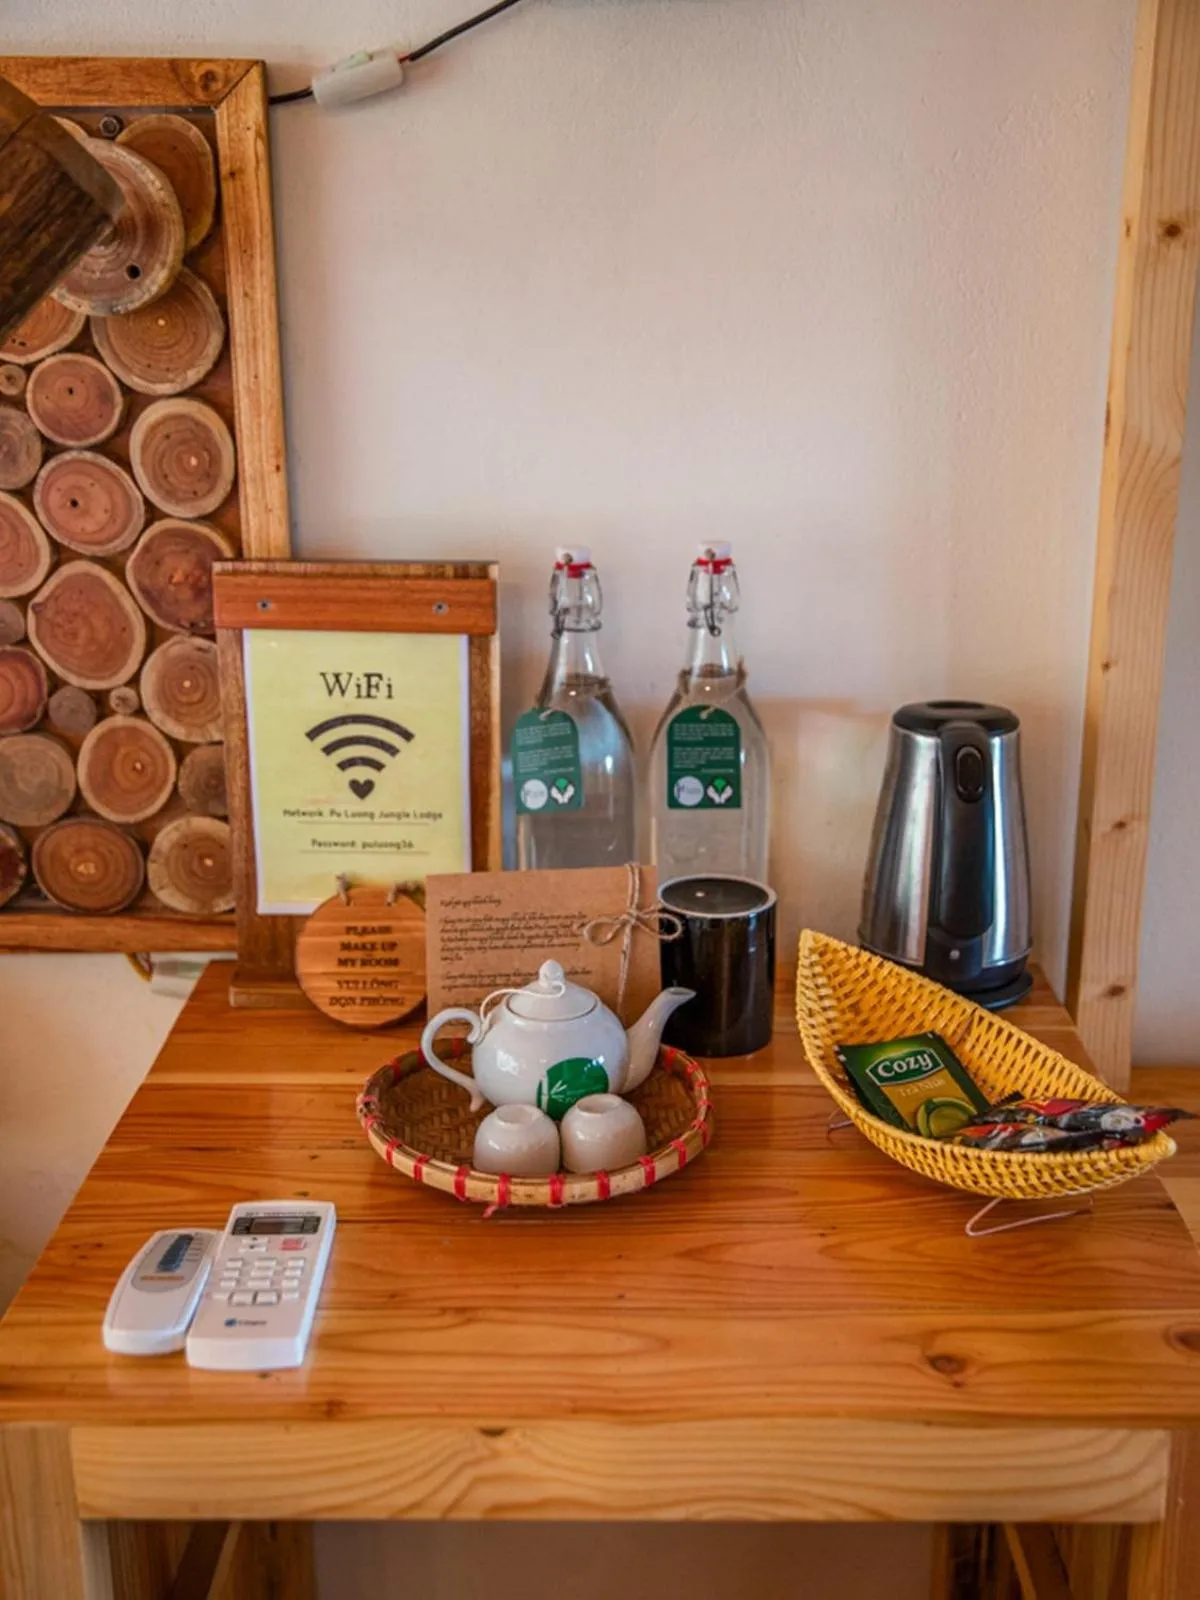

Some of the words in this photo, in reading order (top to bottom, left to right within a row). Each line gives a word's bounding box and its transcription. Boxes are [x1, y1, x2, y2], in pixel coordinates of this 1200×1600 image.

[319, 671, 394, 700] WiFi
[379, 809, 410, 821] Jungle
[413, 809, 443, 822] Lodge
[345, 925, 392, 936] PLEASE
[340, 941, 378, 952] MAKE
[381, 941, 398, 952] UP
[337, 957, 357, 968] MY
[359, 957, 400, 968] ROOM
[876, 1052, 934, 1078] Cozy
